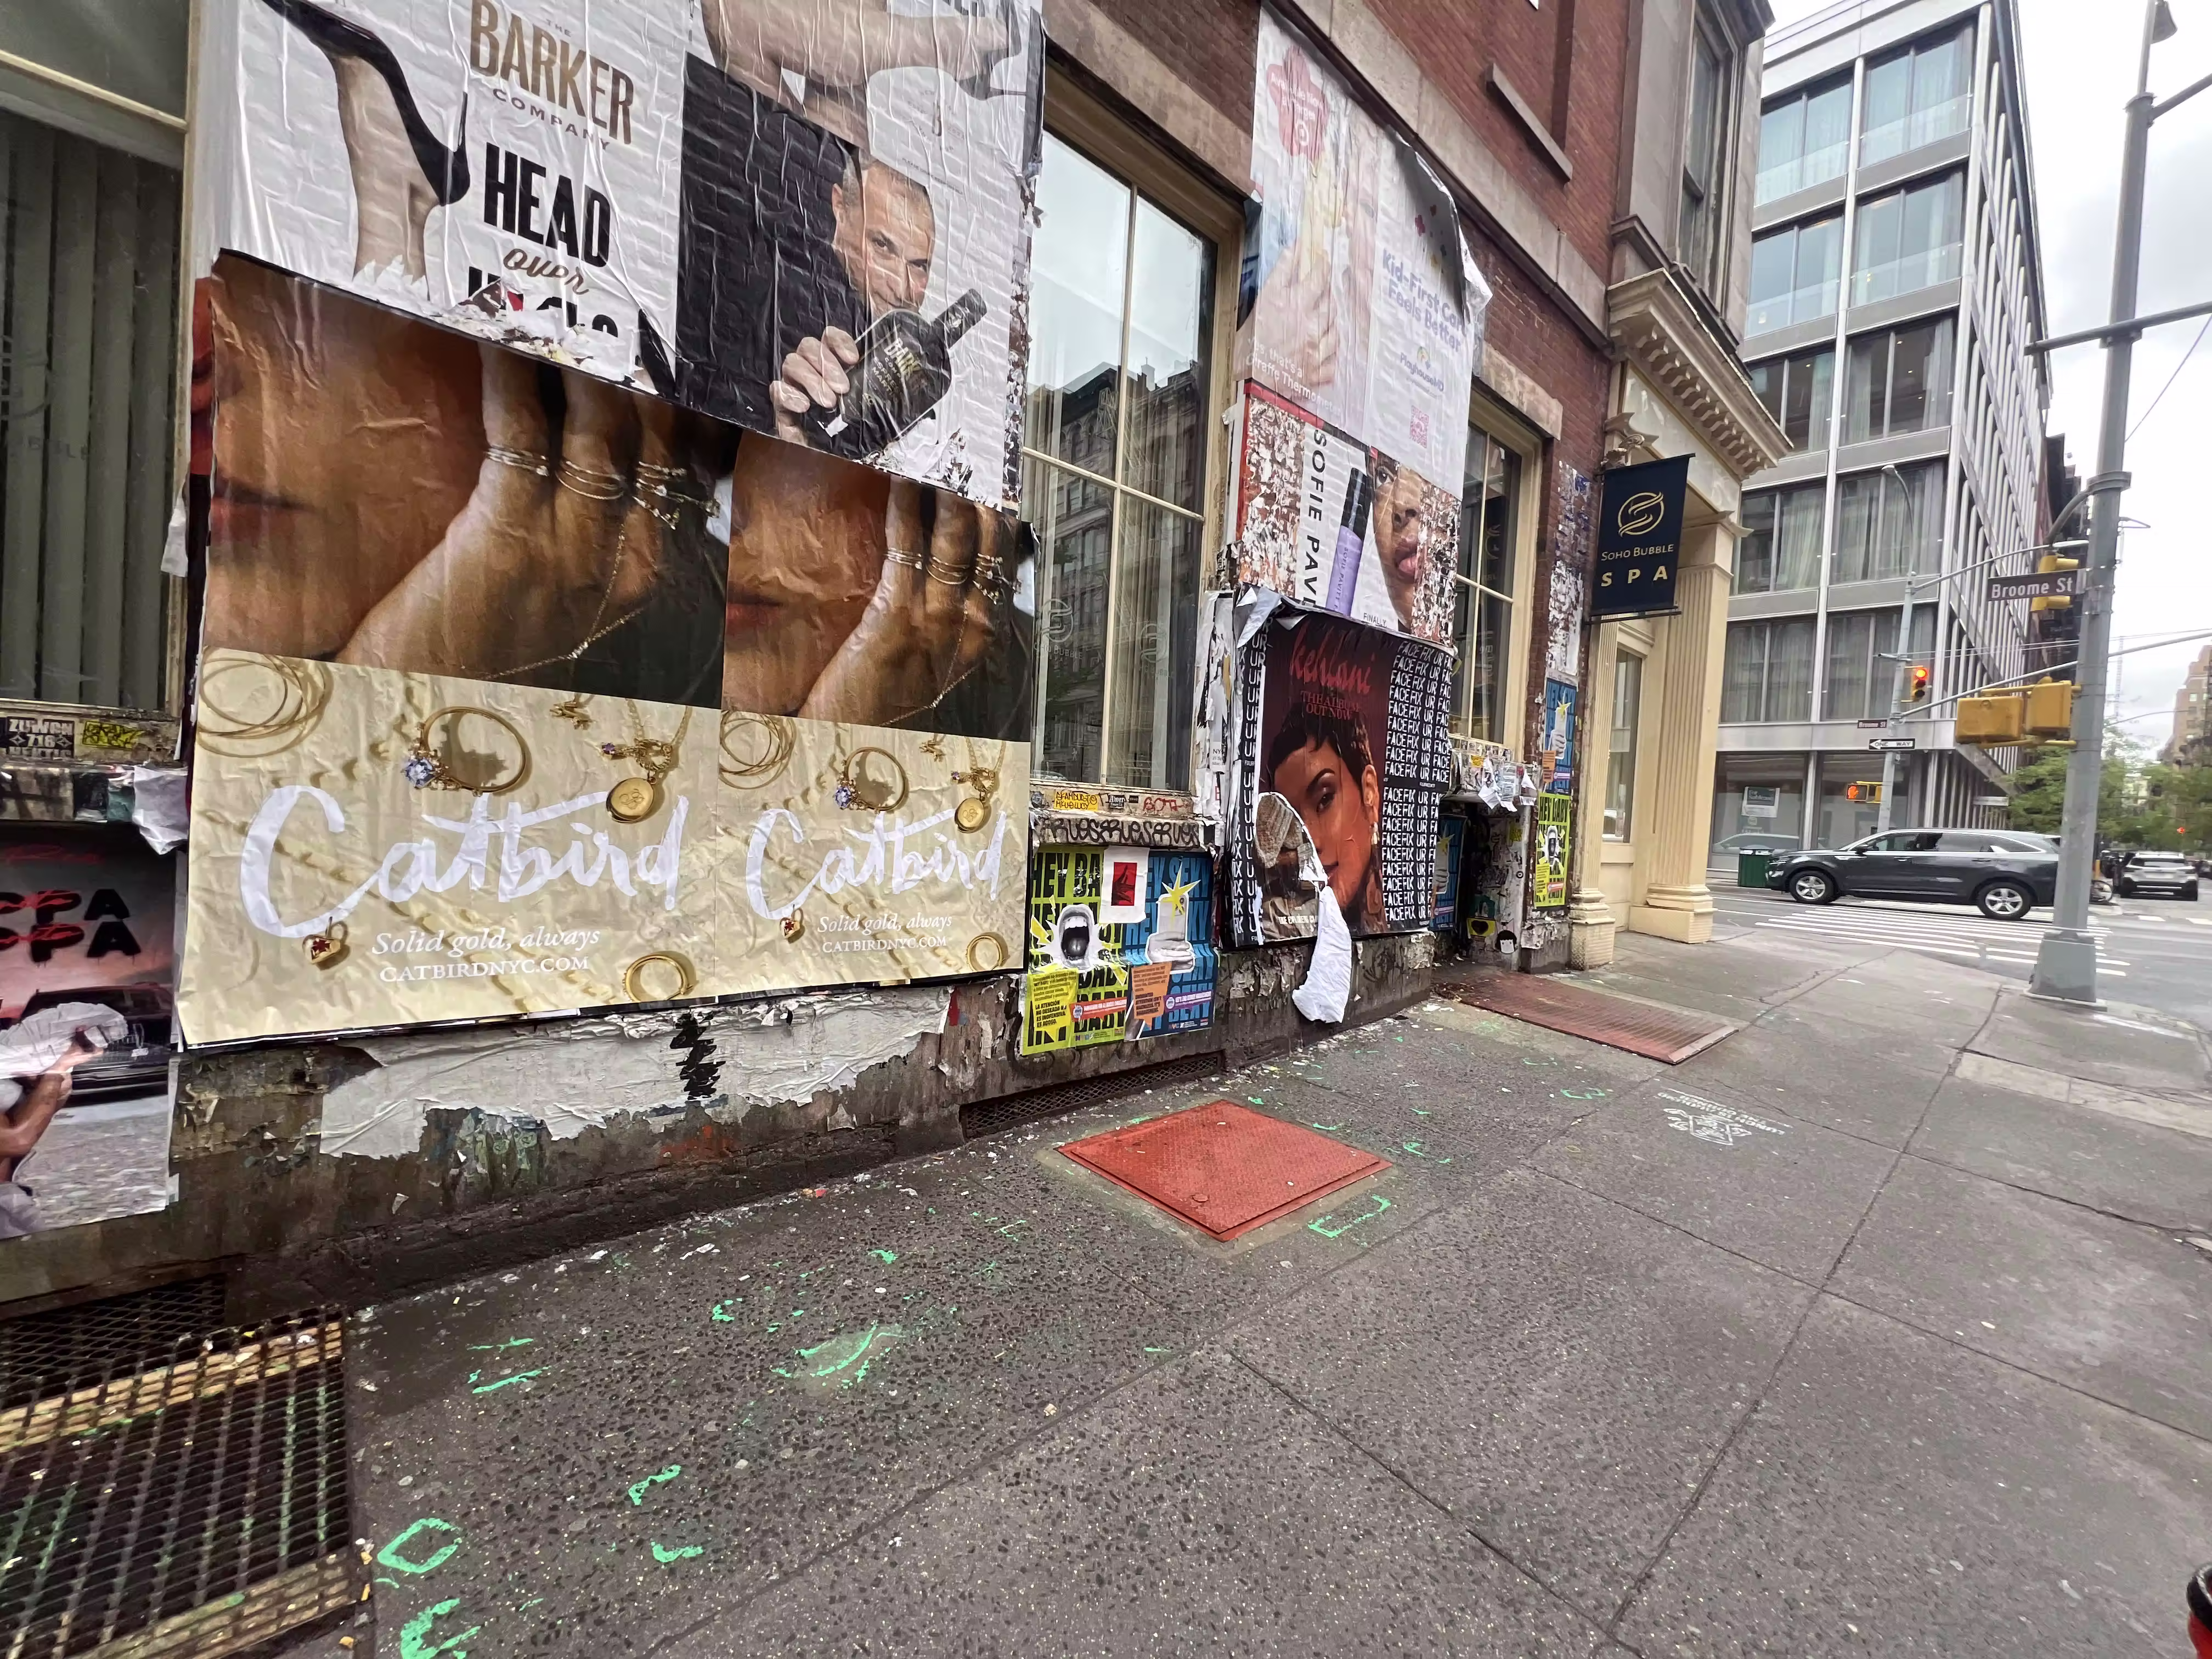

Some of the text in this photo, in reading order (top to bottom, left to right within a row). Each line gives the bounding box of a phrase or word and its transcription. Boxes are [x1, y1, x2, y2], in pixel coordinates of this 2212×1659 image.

[546, 18, 572, 37] THE
[470, 0, 634, 145] BARKER
[493, 88, 610, 150] COMPANY
[483, 142, 611, 268] HEAD
[503, 249, 590, 296] over
[1383, 248, 1440, 314] Kid-First
[1389, 278, 1461, 352] Feels Better
[1308, 429, 1327, 521] SOFIE
[1633, 544, 1674, 557] BUBBLE
[1991, 577, 2073, 599] Broome St
[1398, 641, 1453, 670] FACE FIX UR FAC
[1393, 656, 1452, 684] FACE FIX UR FAC
[1391, 670, 1451, 698] FACE FIX UR FAC
[1389, 686, 1450, 712] FACE FIX UR FAC
[1306, 703, 1353, 720] OUT NOW
[1389, 701, 1449, 726] FACE FIX UR FAC
[1387, 716, 1449, 740] FACE FIX UR FAC
[26, 734, 55, 748] 716
[1386, 731, 1451, 755] FACE FIX UR FACE
[1385, 746, 1450, 769] FACE FIX UR FACE
[1385, 761, 1449, 783] FACE FIX UR FACE
[1384, 787, 1440, 805] FACE FIX UR FA
[1382, 802, 1402, 817] FACE
[1402, 804, 1415, 818] FIX
[1418, 805, 1427, 819] UR
[1382, 817, 1402, 832] FACE
[1402, 819, 1414, 832] FIX
[1417, 819, 1427, 833] UR
[1381, 832, 1437, 848] FACE FIX UR FA
[241, 785, 689, 938] Catbird
[745, 808, 1007, 919] Catbird
[1381, 848, 1426, 862] FACE FIX UR
[1031, 851, 1101, 898] HEY BA
[1147, 857, 1166, 899] EY
[1382, 862, 1425, 876] FACE FIX UR
[1382, 877, 1425, 891] FACE FIX UR
[0, 888, 130, 925] PA
[1383, 891, 1425, 907] FACE FIX UR
[817, 912, 952, 936] Solid gold, always
[1385, 906, 1426, 922] FACE FIX UR
[0, 921, 142, 963] PA
[371, 927, 601, 958] Solid gold, always
[821, 936, 947, 953] CATBIRDNYC.COM
[379, 955, 589, 983] CATBIRDNYC.COM
